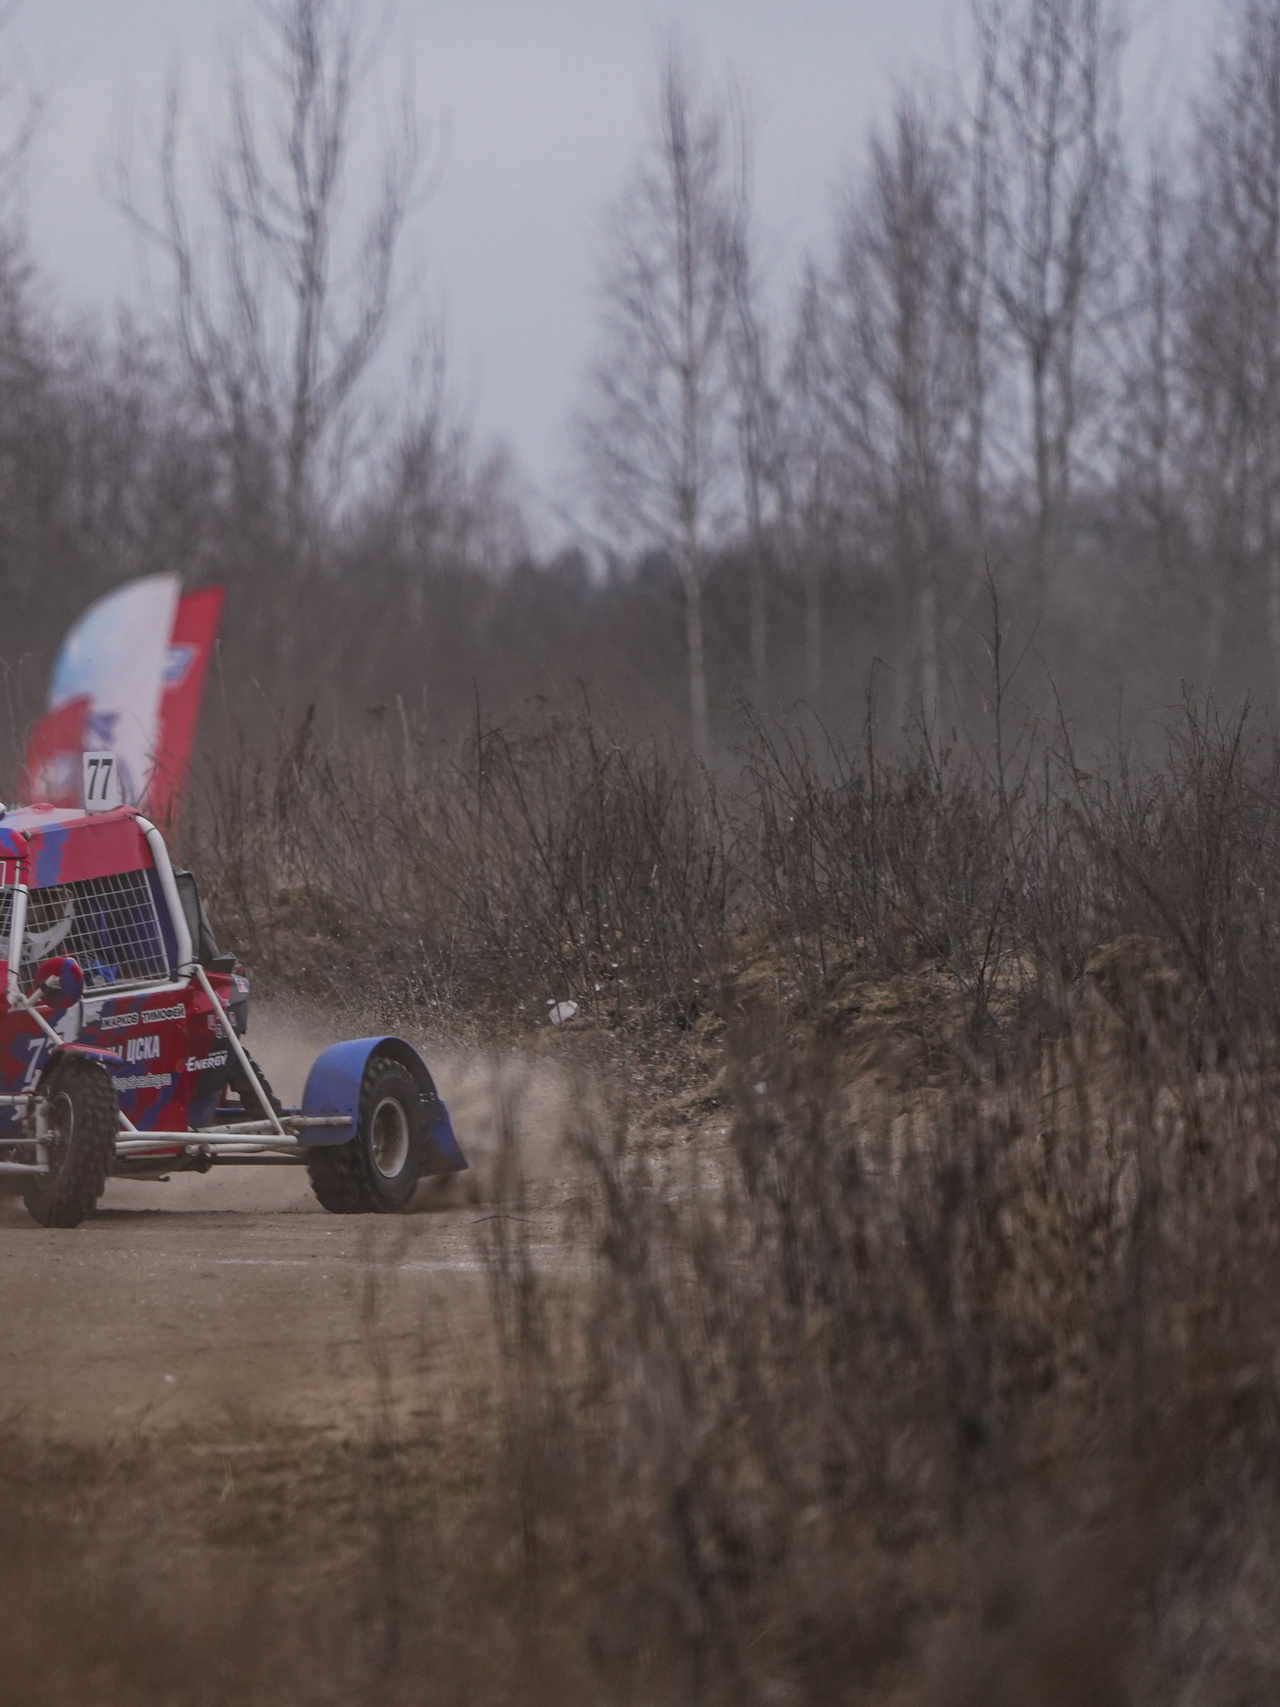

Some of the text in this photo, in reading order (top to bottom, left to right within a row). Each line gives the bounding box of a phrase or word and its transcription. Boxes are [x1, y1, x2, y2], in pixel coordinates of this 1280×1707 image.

[87, 758, 113, 800] 77
[141, 1003, 186, 1024] ТИМОФЕЙ
[126, 1035, 160, 1064] ЦСКА
